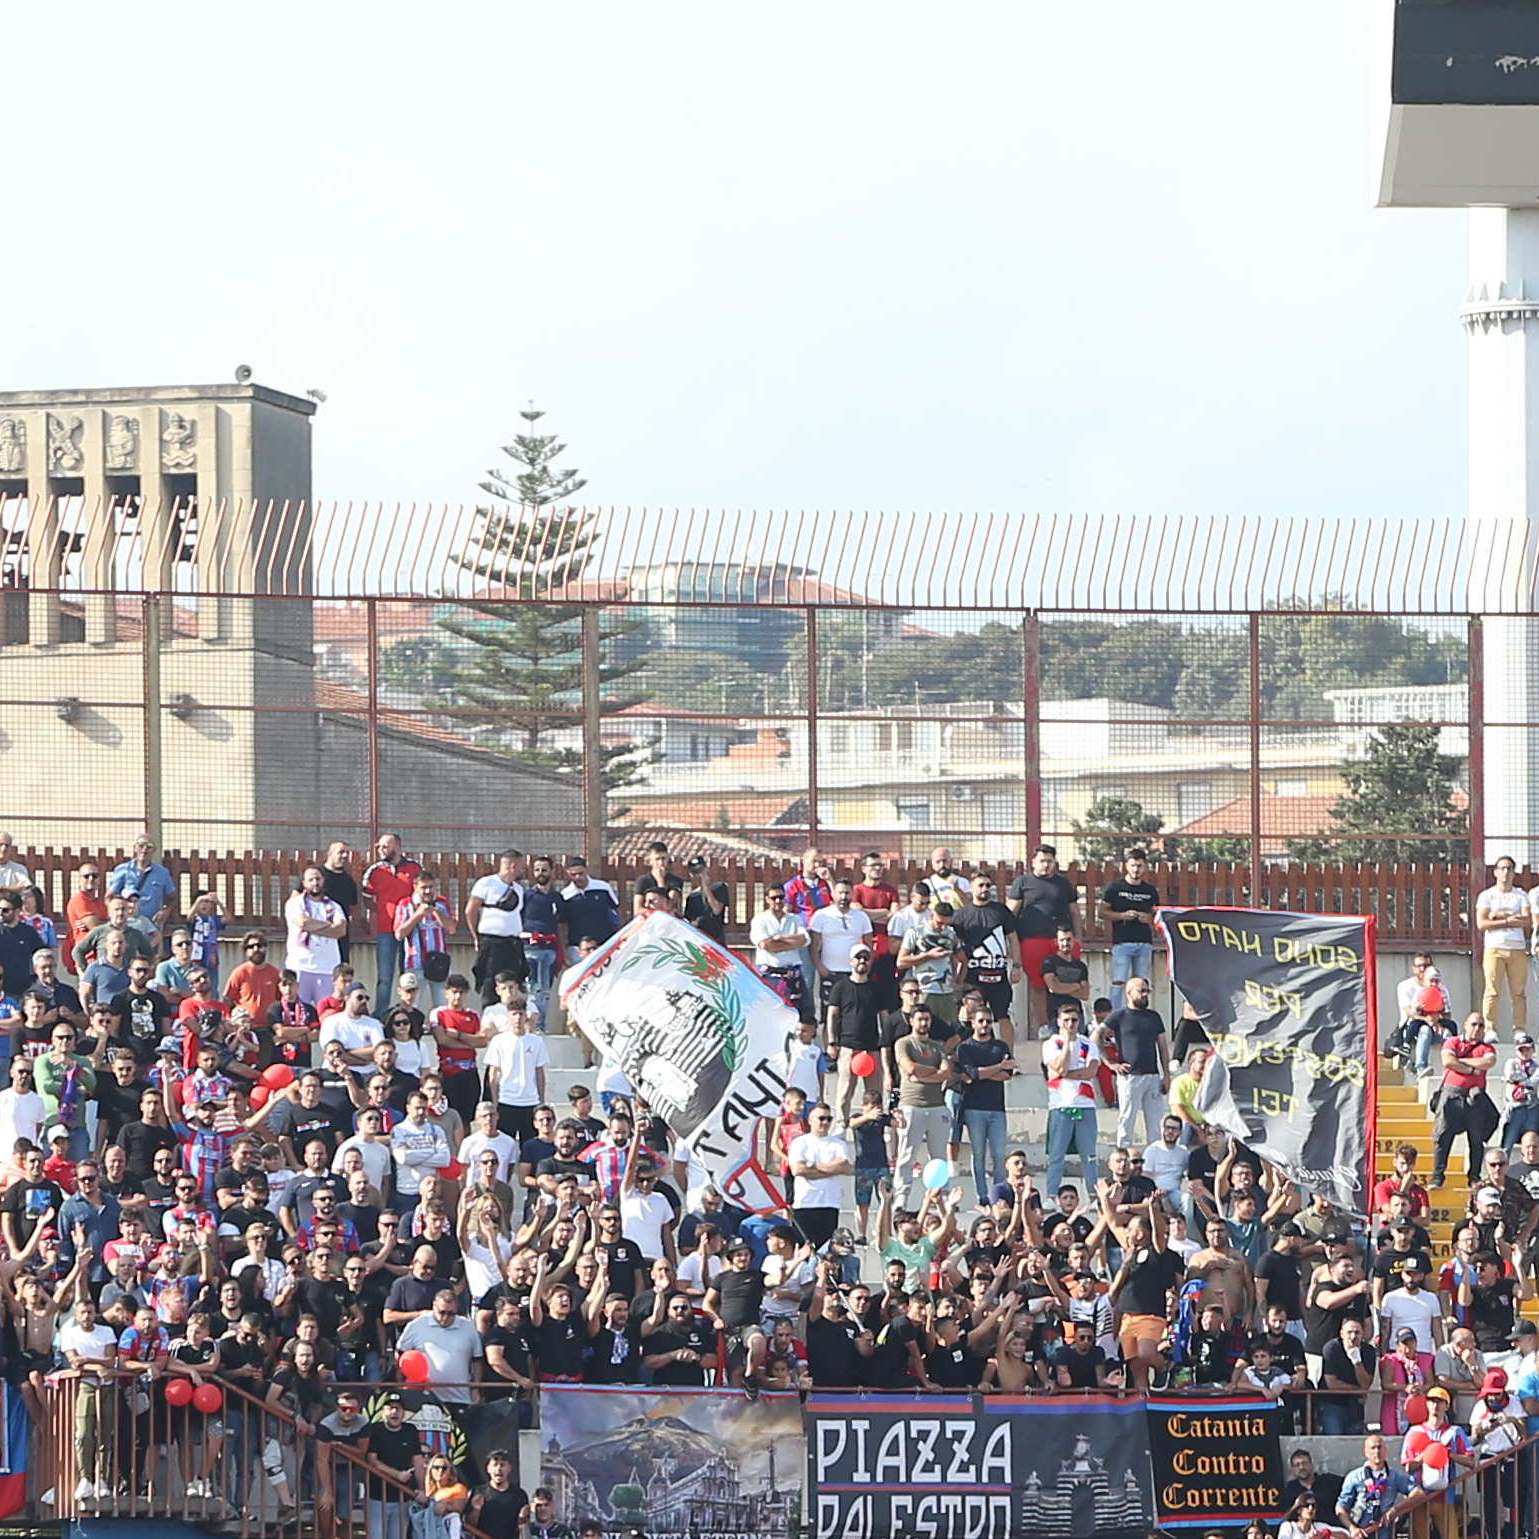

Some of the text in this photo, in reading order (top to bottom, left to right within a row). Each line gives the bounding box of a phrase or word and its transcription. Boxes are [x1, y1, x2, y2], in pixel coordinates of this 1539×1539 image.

[1167, 1413, 1266, 1440] Catania
[816, 1419, 1012, 1484] PIAZZA
[1172, 1449, 1266, 1476] Contro
[1163, 1483, 1280, 1510] Corrente
